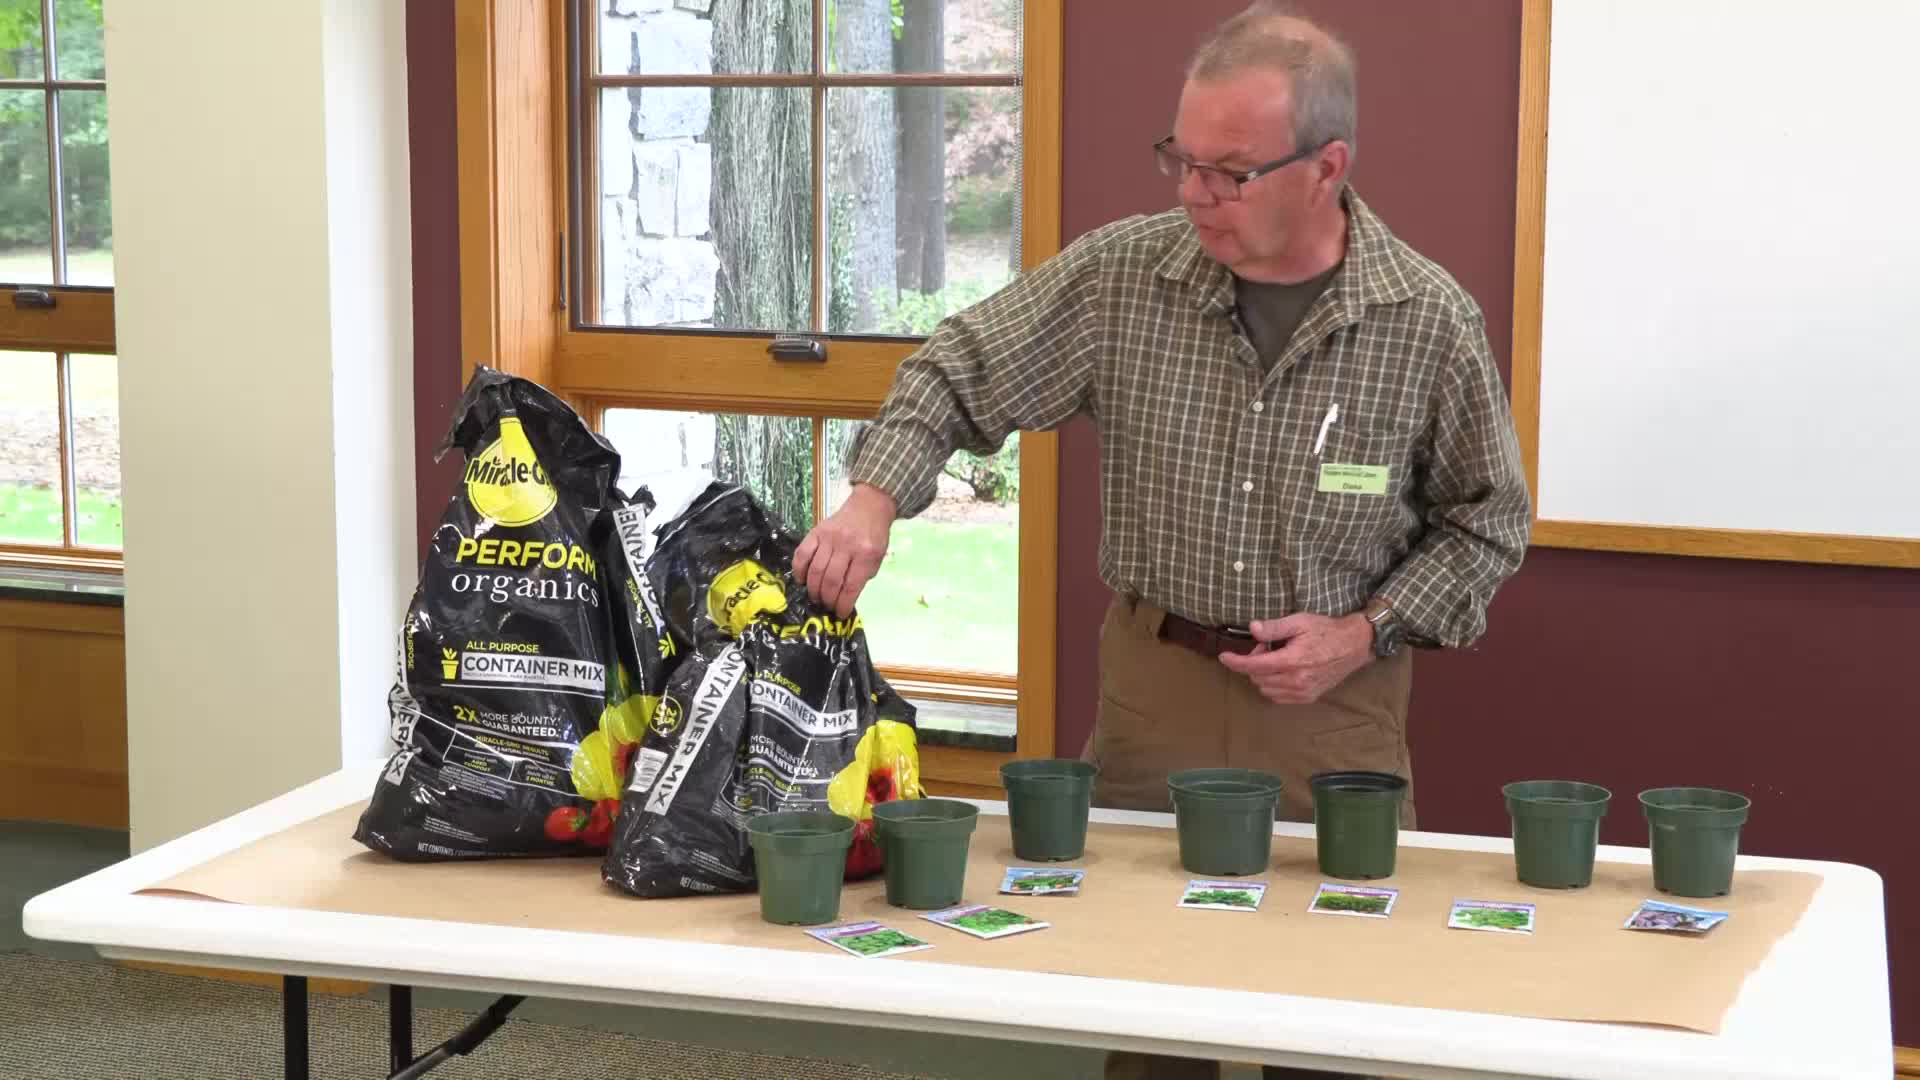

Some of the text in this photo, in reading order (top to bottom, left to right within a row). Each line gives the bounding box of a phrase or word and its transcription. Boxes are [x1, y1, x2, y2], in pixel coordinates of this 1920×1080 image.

[451, 572, 599, 607] organics
[466, 640, 540, 654] ALL PURPOSE
[463, 656, 569, 677] CONTAINER
[573, 665, 604, 682] MIX
[453, 704, 481, 723] 2X
[480, 711, 508, 723] MORE
[682, 650, 745, 756] ONTAINER
[752, 683, 853, 728] ONTAINER MIX
[653, 764, 684, 808] MIX
[417, 842, 428, 853] NET
